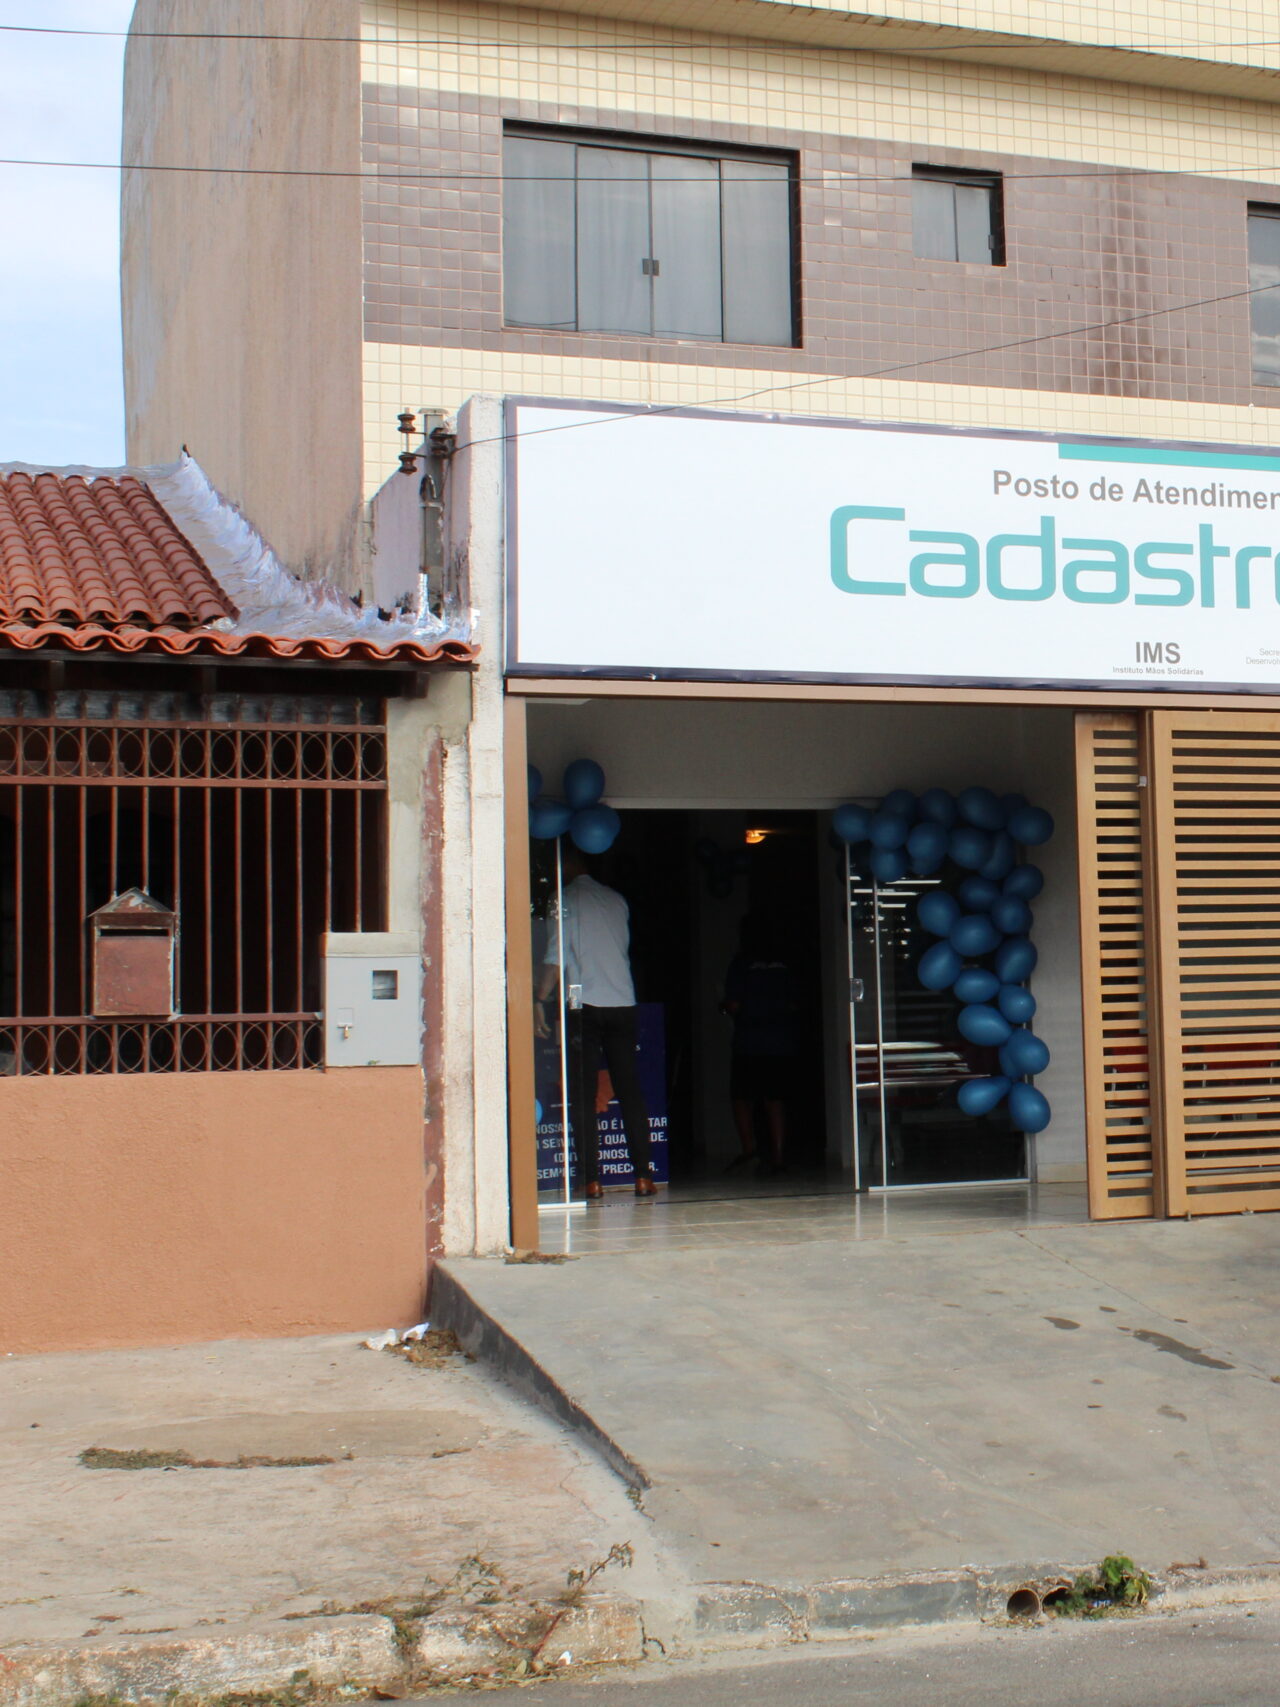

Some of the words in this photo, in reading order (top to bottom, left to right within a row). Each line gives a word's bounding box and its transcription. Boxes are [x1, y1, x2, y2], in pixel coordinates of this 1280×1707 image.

[993, 469, 1079, 500] Posto
[1089, 475, 1124, 502] de
[1135, 641, 1181, 664] IMS
[1112, 666, 1144, 674] Instituto
[1145, 667, 1166, 675] Mãos
[1167, 667, 1204, 676] Solidárias
